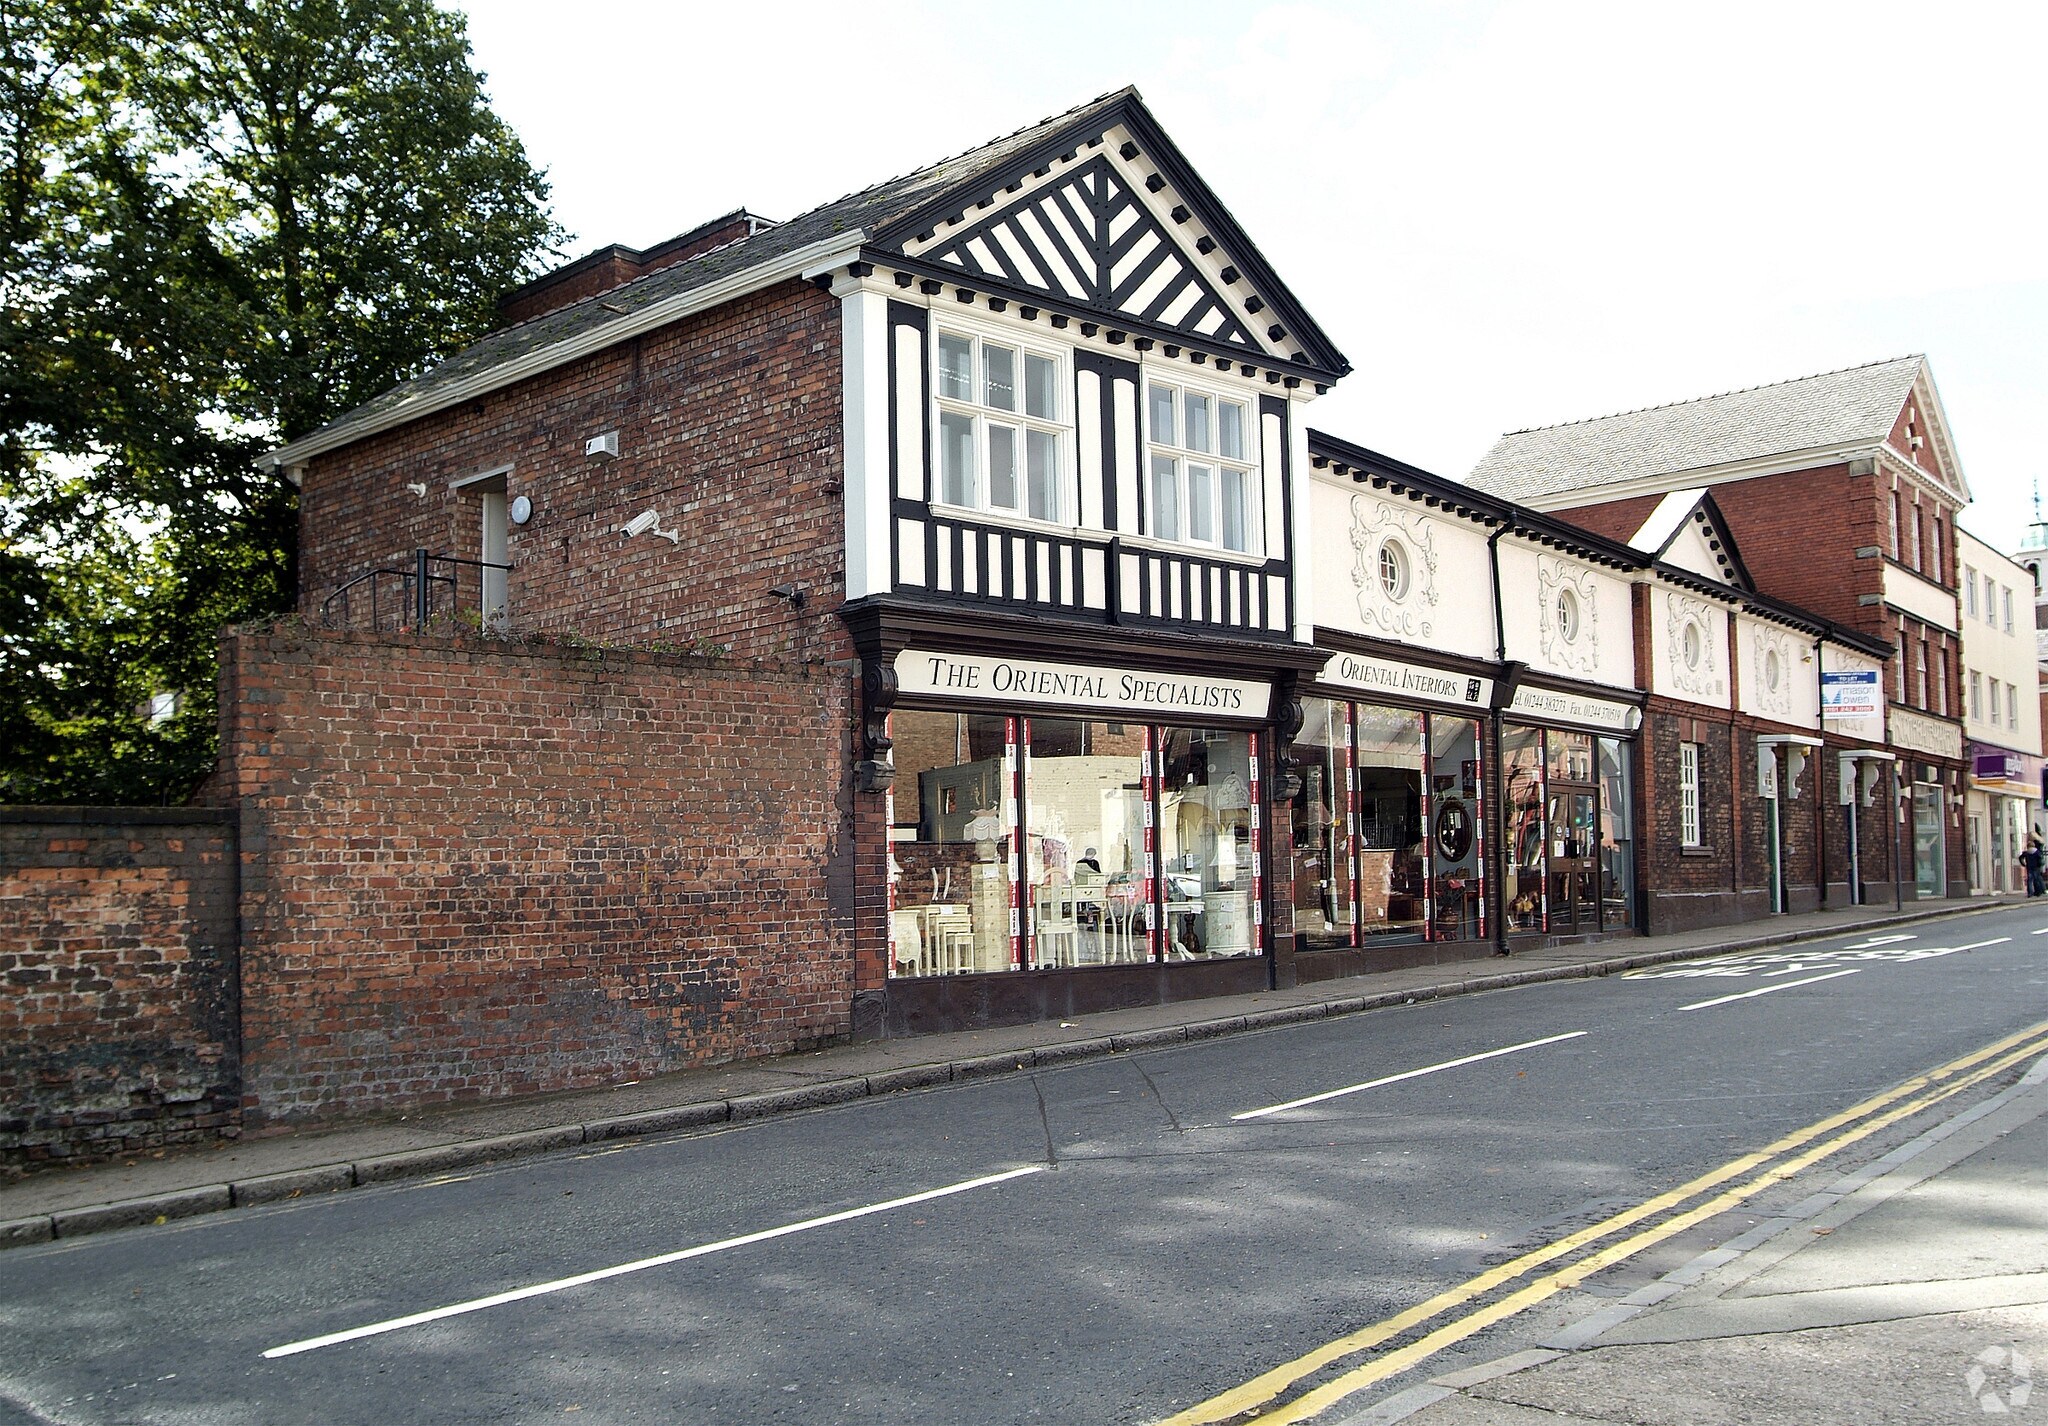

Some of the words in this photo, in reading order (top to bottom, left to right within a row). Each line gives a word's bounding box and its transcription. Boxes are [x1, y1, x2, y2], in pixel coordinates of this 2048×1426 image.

[928, 657, 981, 689] THE
[992, 663, 1109, 699] ORIENTAL
[1118, 674, 1242, 709] SPECIALISTS
[1341, 656, 1399, 687] ORIENTAL
[1401, 668, 1457, 697] INTERIORS
[1524, 693, 1542, 709] 01244
[1583, 704, 1601, 718] 01244
[1844, 696, 1870, 704] owen
